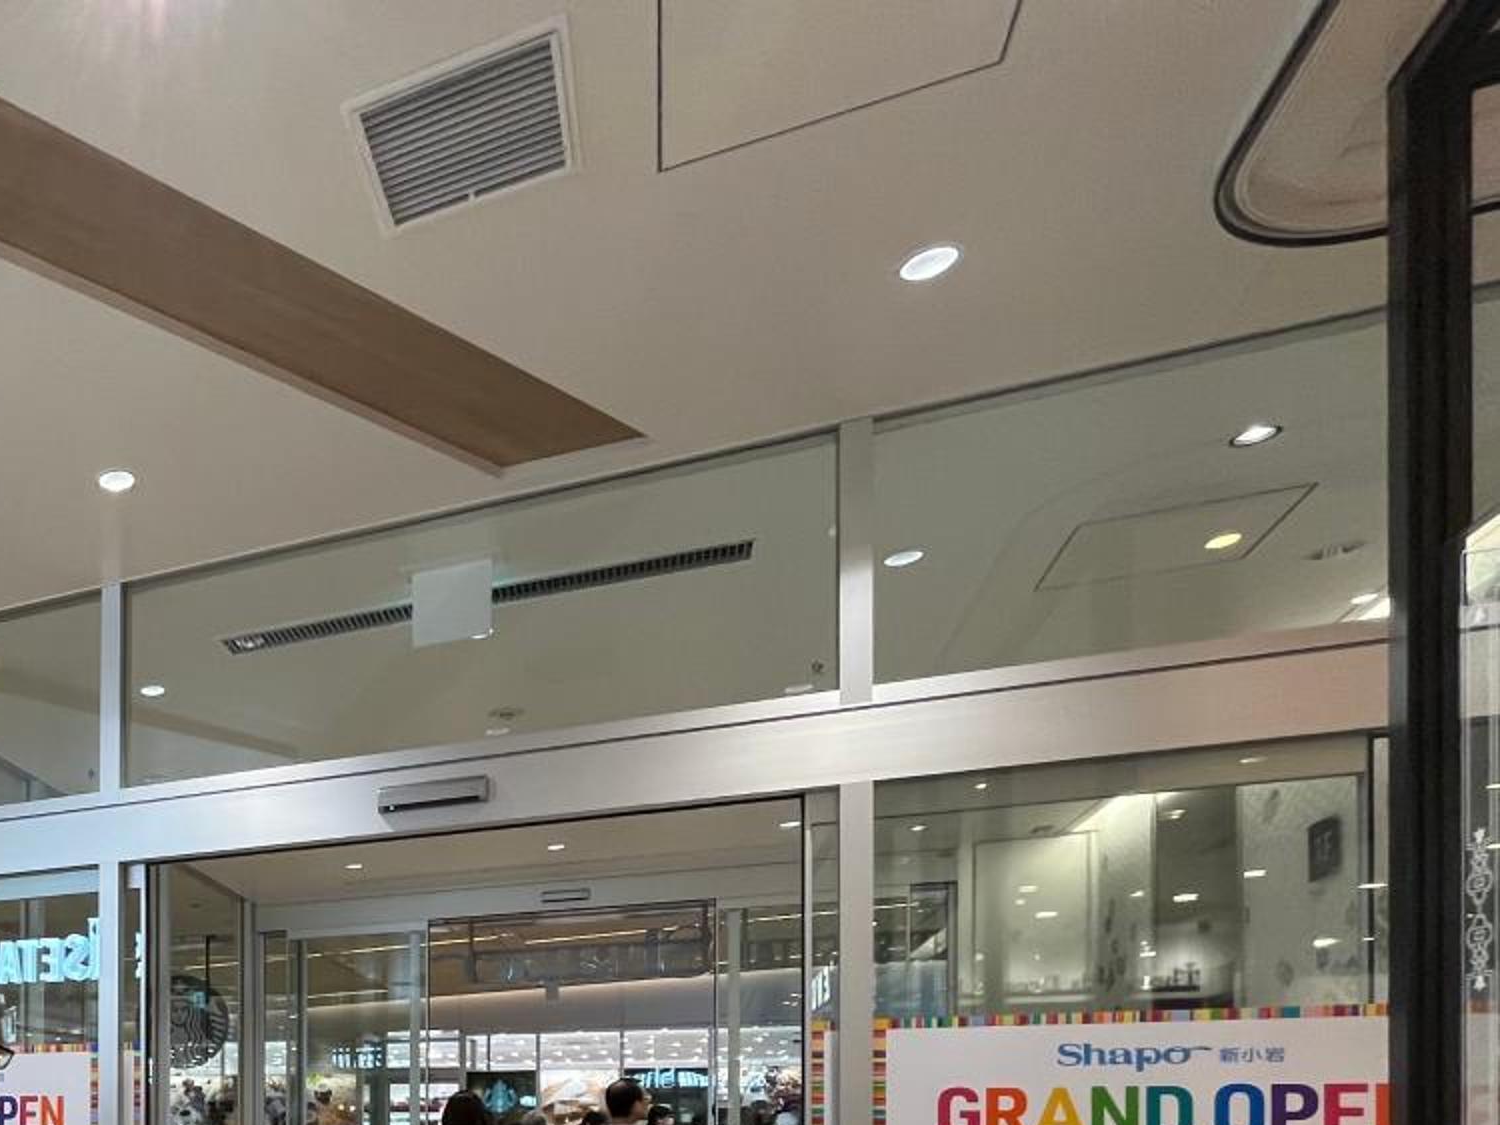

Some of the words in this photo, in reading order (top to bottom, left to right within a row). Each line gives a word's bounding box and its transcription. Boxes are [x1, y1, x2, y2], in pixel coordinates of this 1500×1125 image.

[1057, 1043, 1211, 1072] Shapo
[1219, 1046, 1285, 1063] 新小岩
